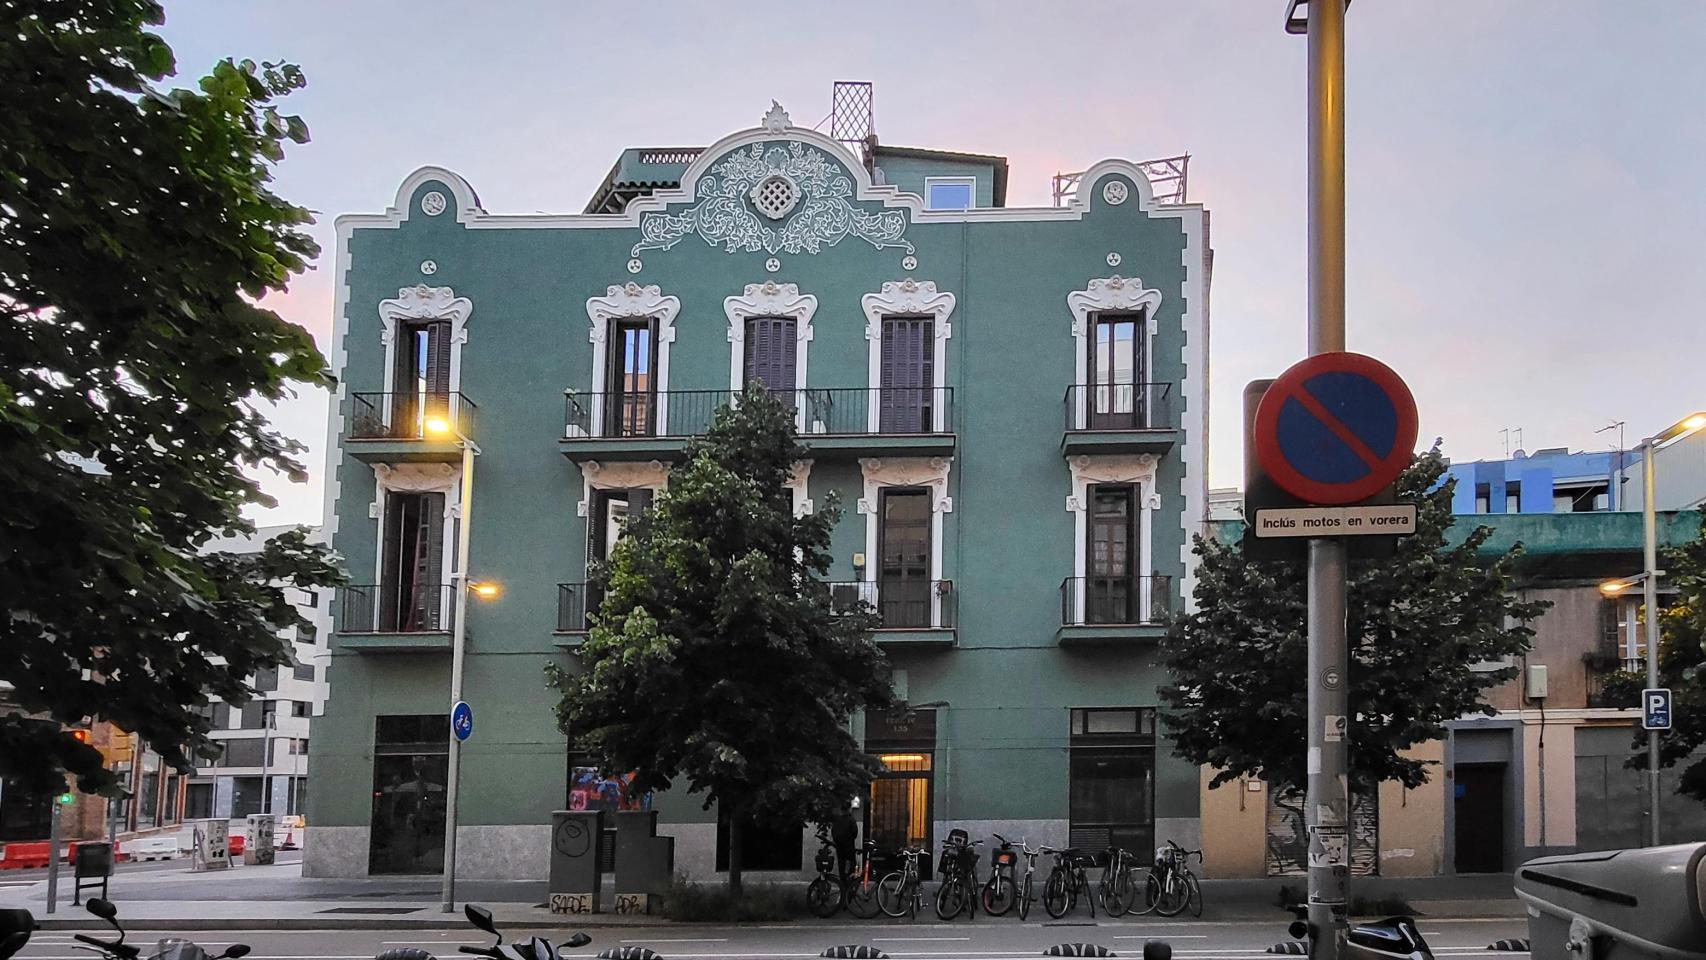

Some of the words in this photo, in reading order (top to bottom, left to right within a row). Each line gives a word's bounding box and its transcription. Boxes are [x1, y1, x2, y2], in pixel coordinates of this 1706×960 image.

[1263, 516, 1296, 529] Inclús
[1303, 516, 1341, 528] motos
[1348, 518, 1362, 527] en
[1369, 515, 1409, 526] vorera
[1649, 695, 1665, 714] P
